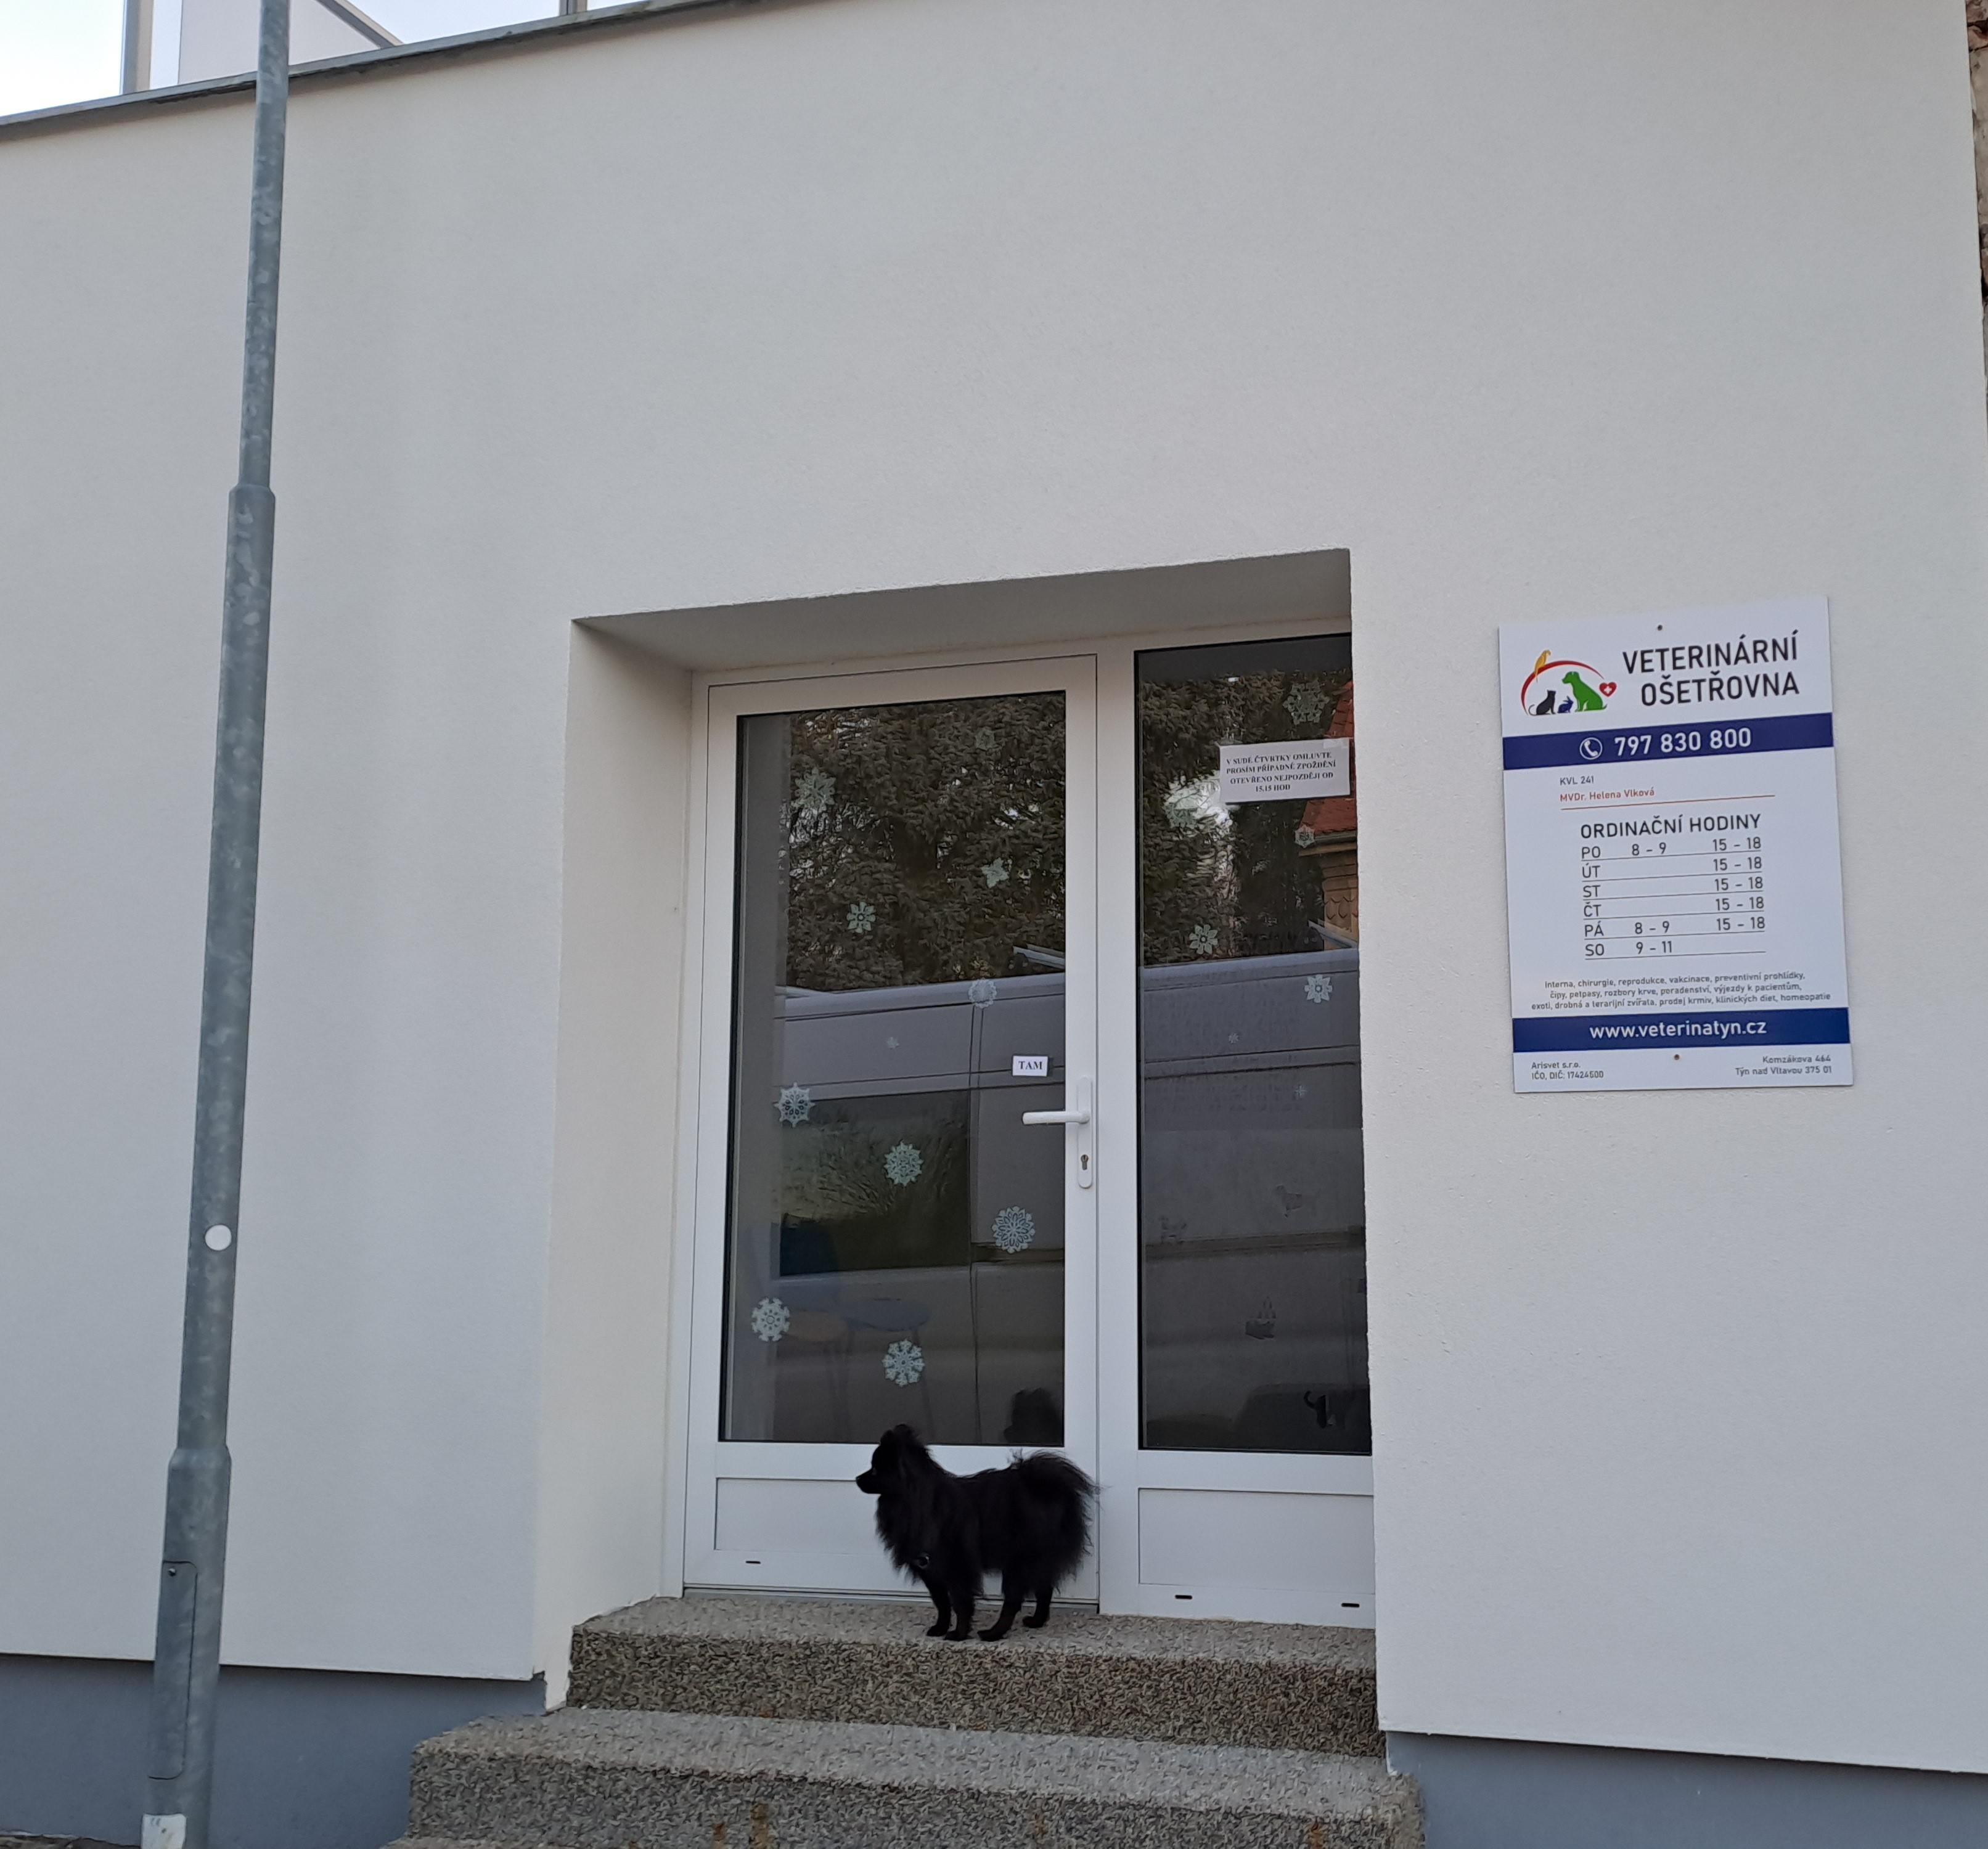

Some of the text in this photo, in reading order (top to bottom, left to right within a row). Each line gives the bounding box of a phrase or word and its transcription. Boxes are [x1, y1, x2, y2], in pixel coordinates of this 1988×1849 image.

[1622, 629, 1799, 674] VETERINÁRNÍ
[1641, 671, 1799, 706] OŠETŘOVNA
[1614, 727, 1751, 756] 797 830 800
[1293, 752, 1331, 760] OMLUVTE
[1227, 764, 1255, 774] PROSÍM
[1297, 759, 1336, 769] ZPOŽDĚNÍ
[1230, 776, 1272, 785] OTEVŘENO
[1560, 775, 1593, 785] KVL 241
[1560, 786, 1655, 801] MVDr. Helena Vlková
[1581, 813, 1761, 839] ORDINAČNÍ HODINY
[1582, 845, 1601, 859] PO
[1632, 844, 1640, 855] 8
[1659, 843, 1666, 855] 9
[1713, 839, 1727, 852] 15
[1747, 837, 1761, 850] 18
[1582, 862, 1600, 879] ÚT
[1714, 859, 1727, 871] 15
[1748, 856, 1761, 870] 18
[1582, 884, 1601, 898] ST
[1715, 878, 1728, 891] 15
[1749, 876, 1762, 889] 18
[1583, 900, 1601, 918] ČT
[1716, 898, 1730, 911] 15
[1750, 896, 1764, 910] 18
[1584, 921, 1604, 937] PÁ
[1635, 923, 1642, 934] 8
[1662, 921, 1669, 933] 9
[1717, 918, 1730, 931] 15
[1751, 916, 1765, 929] 18
[1585, 943, 1605, 957] SO
[1636, 942, 1643, 954] 9
[1663, 941, 1672, 953] 11
[1555, 1001, 1582, 1010] drobná
[1780, 993, 1831, 1002] homeopatie
[1605, 989, 1635, 997] rozbory
[1638, 988, 1658, 996] krve,
[1590, 1019, 1767, 1040] www.veterinatyn.cz
[1018, 1061, 1042, 1069] TAM
[1532, 1061, 1559, 1069] Arisvet
